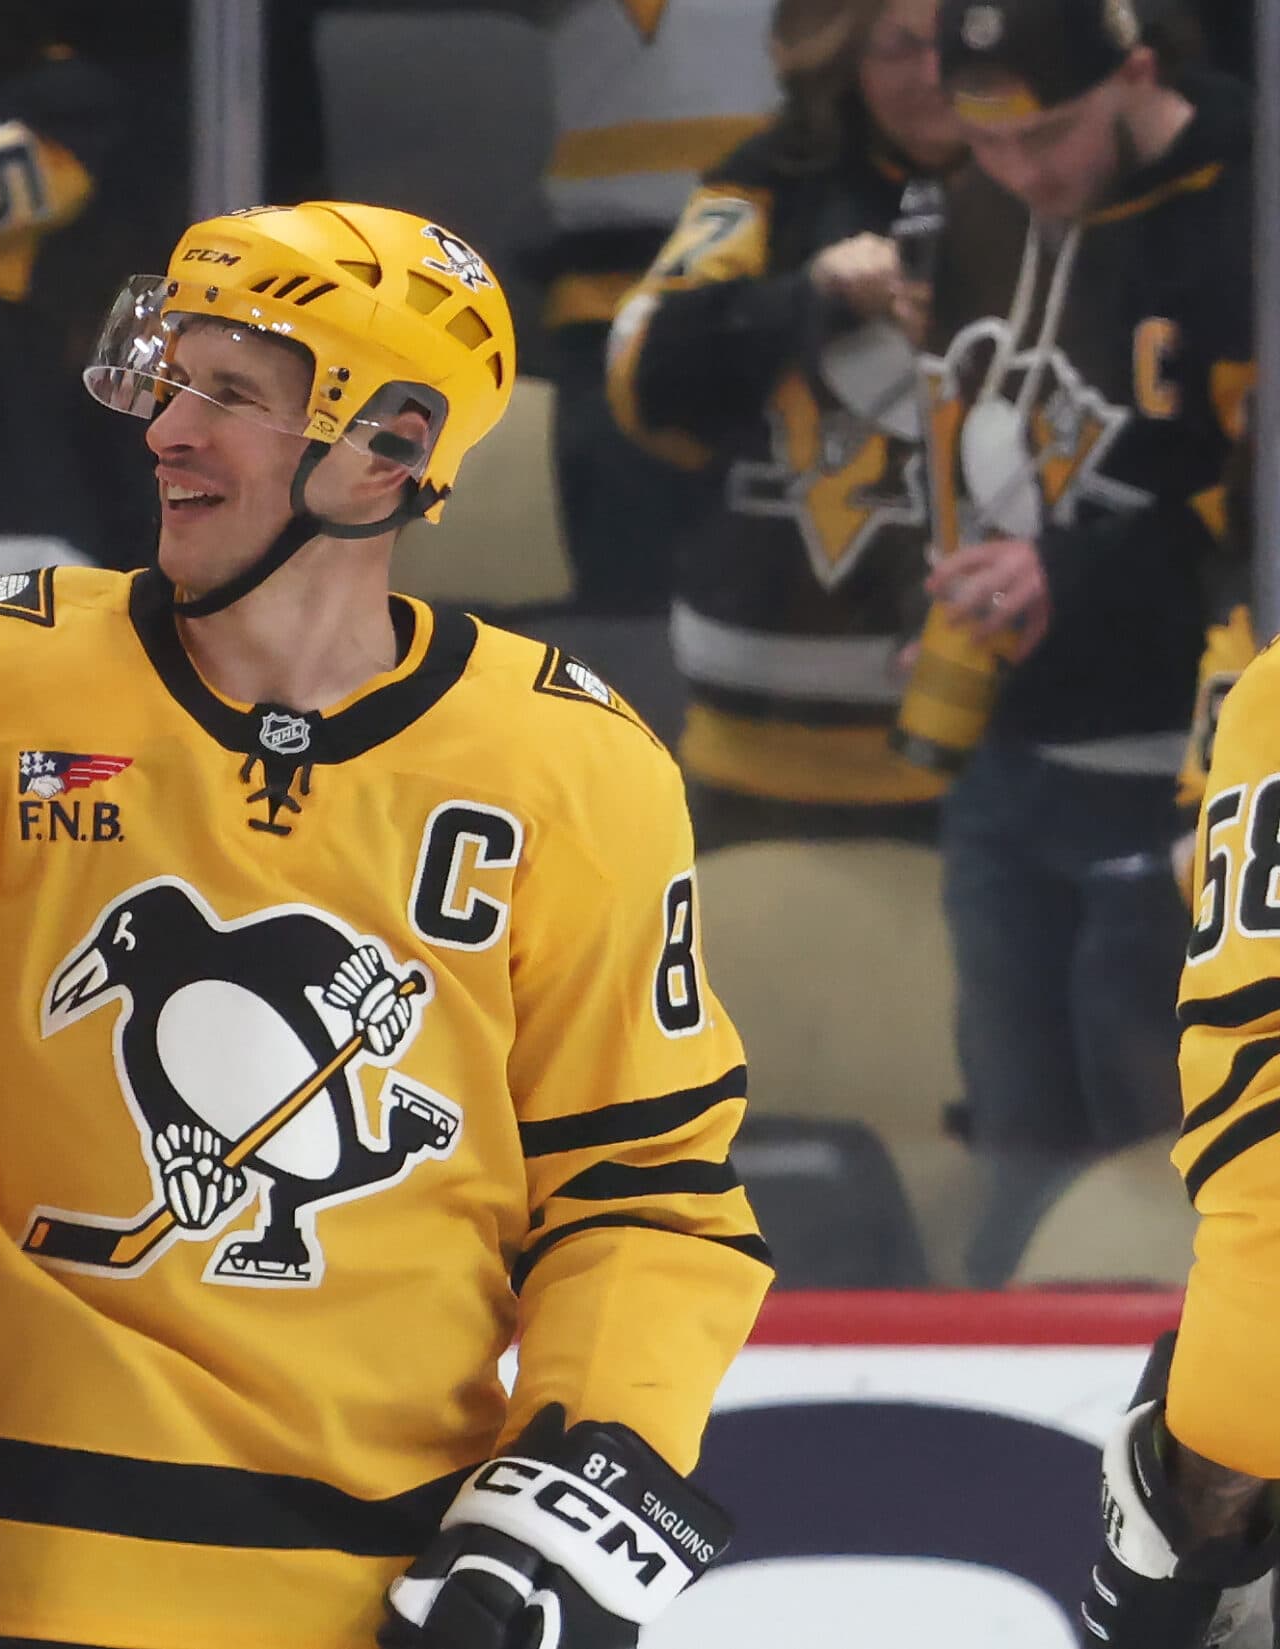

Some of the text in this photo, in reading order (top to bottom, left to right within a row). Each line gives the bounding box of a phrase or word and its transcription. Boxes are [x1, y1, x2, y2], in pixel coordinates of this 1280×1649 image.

[181, 248, 242, 267] CCM
[1132, 315, 1180, 420] C
[18, 799, 125, 843] F.N.B.
[407, 799, 524, 952] C
[582, 1452, 628, 1490] 87
[473, 1460, 667, 1588] CCM
